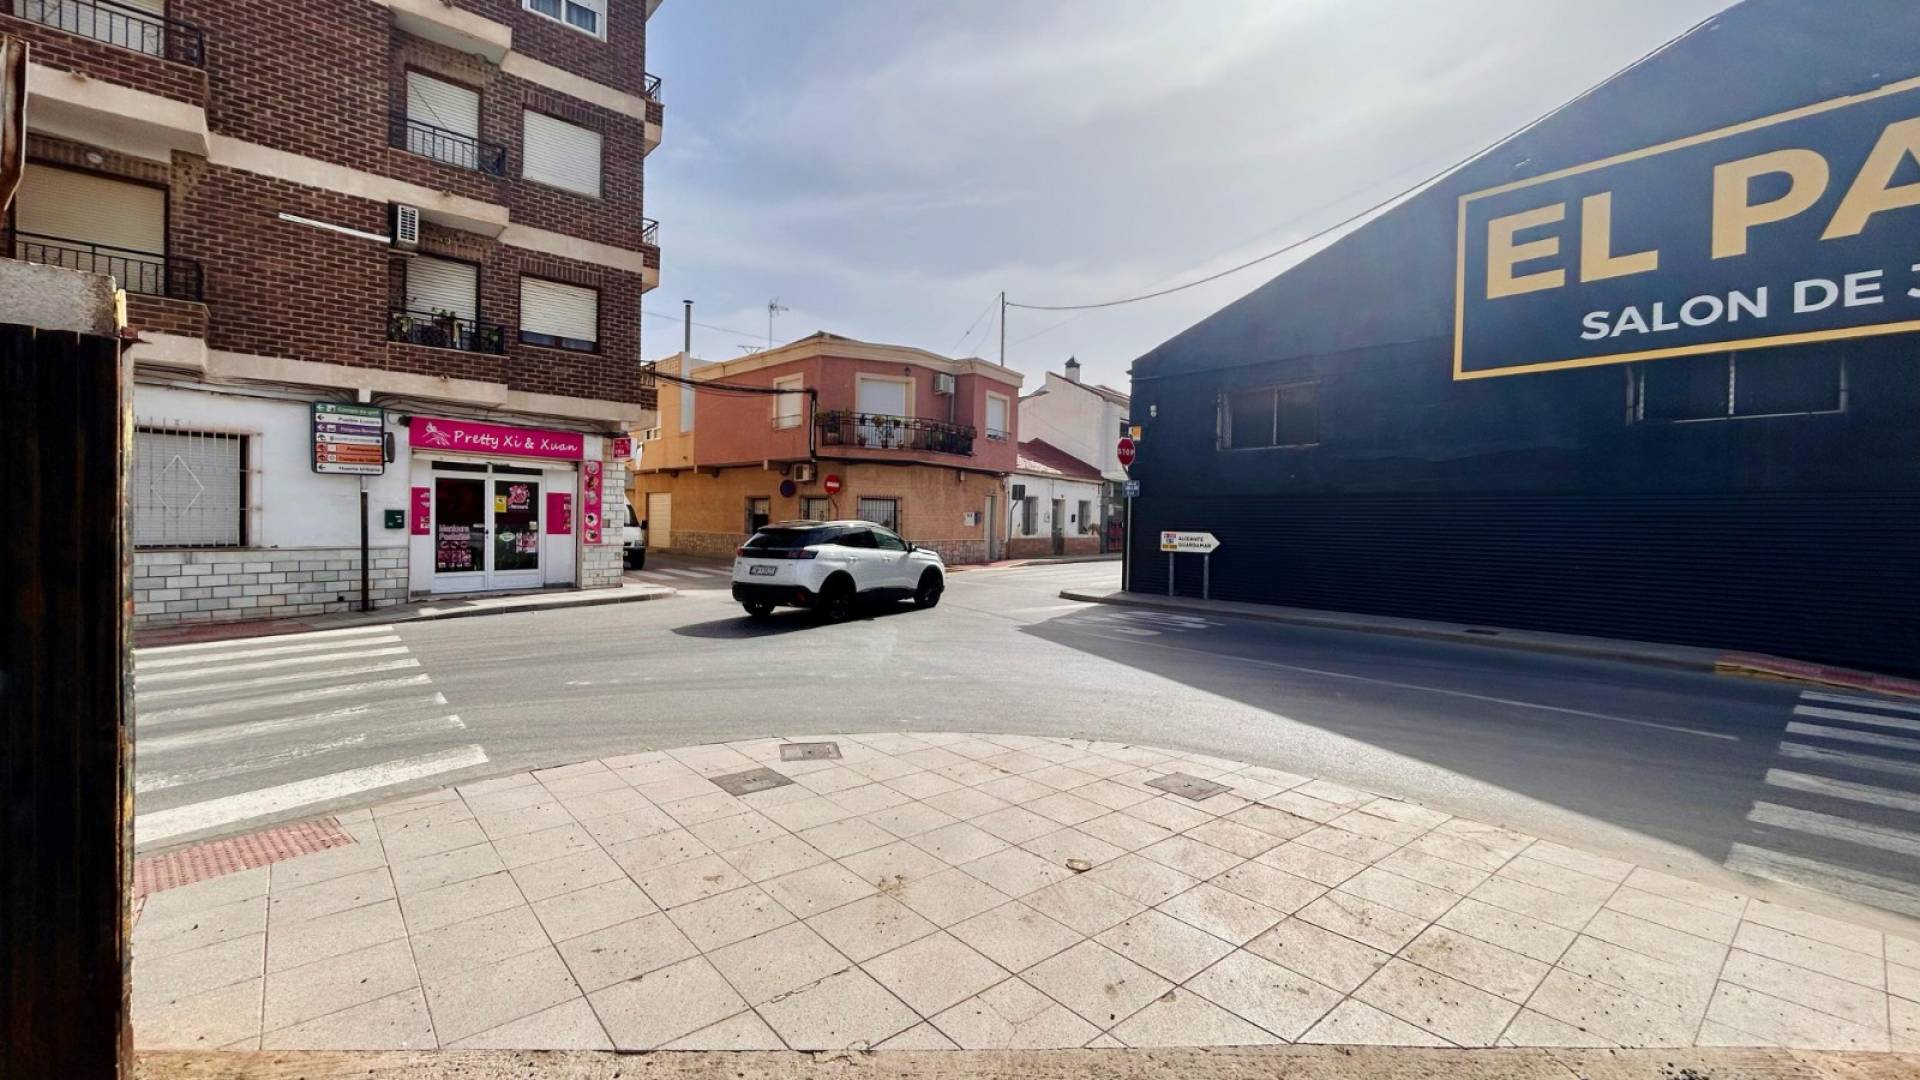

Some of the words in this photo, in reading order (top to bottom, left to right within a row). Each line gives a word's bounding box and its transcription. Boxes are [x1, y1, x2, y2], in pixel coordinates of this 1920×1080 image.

[1487, 192, 1658, 299] EL
[1580, 286, 1769, 341] SALON
[1794, 269, 1884, 314] DE
[453, 430, 499, 450] Pretty
[503, 435, 522, 448] Xi
[524, 437, 535, 449] &
[540, 439, 578, 452] Xuan
[1117, 448, 1135, 456] STOP
